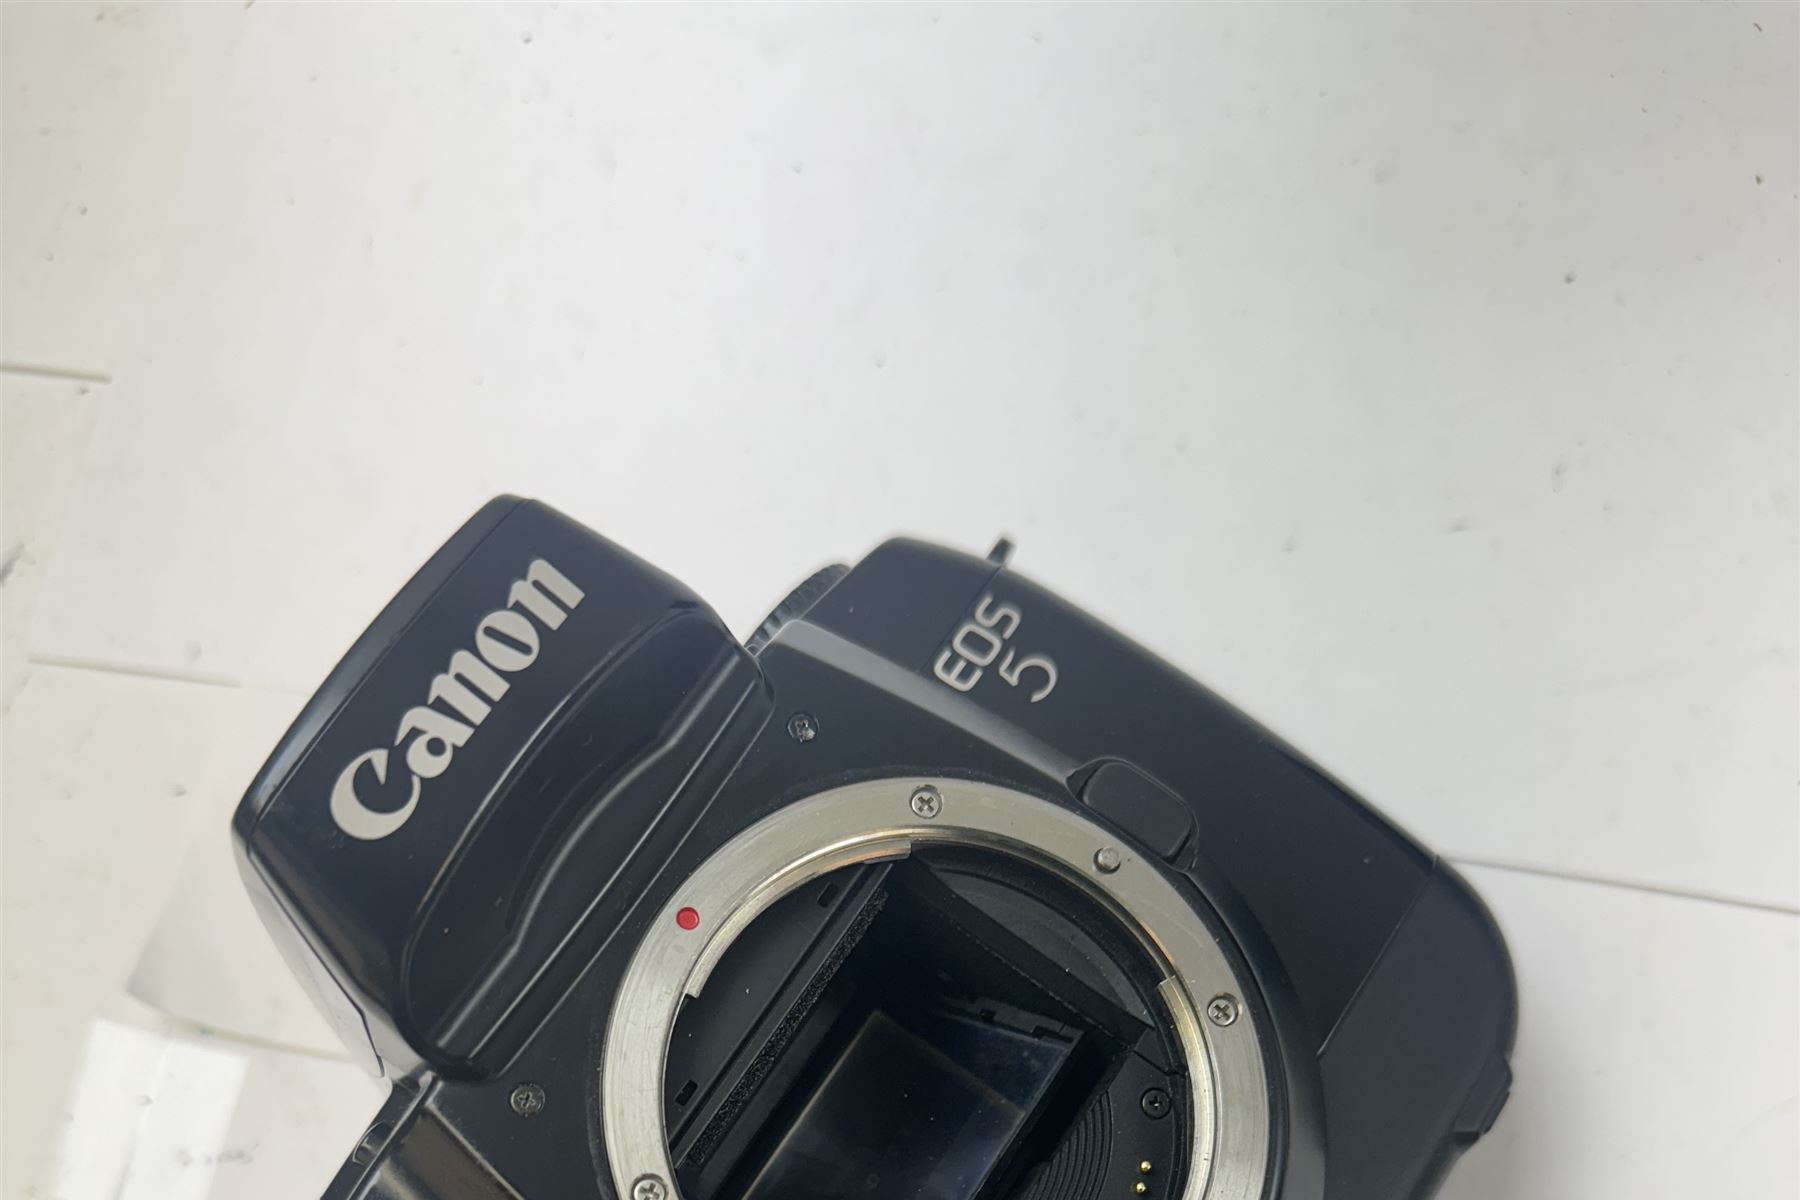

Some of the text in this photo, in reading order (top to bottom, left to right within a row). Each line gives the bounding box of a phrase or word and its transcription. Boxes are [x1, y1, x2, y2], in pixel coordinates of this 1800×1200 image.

[933, 595, 1021, 692] EOS
[999, 649, 1057, 703] 5
[330, 559, 585, 840] Canon
